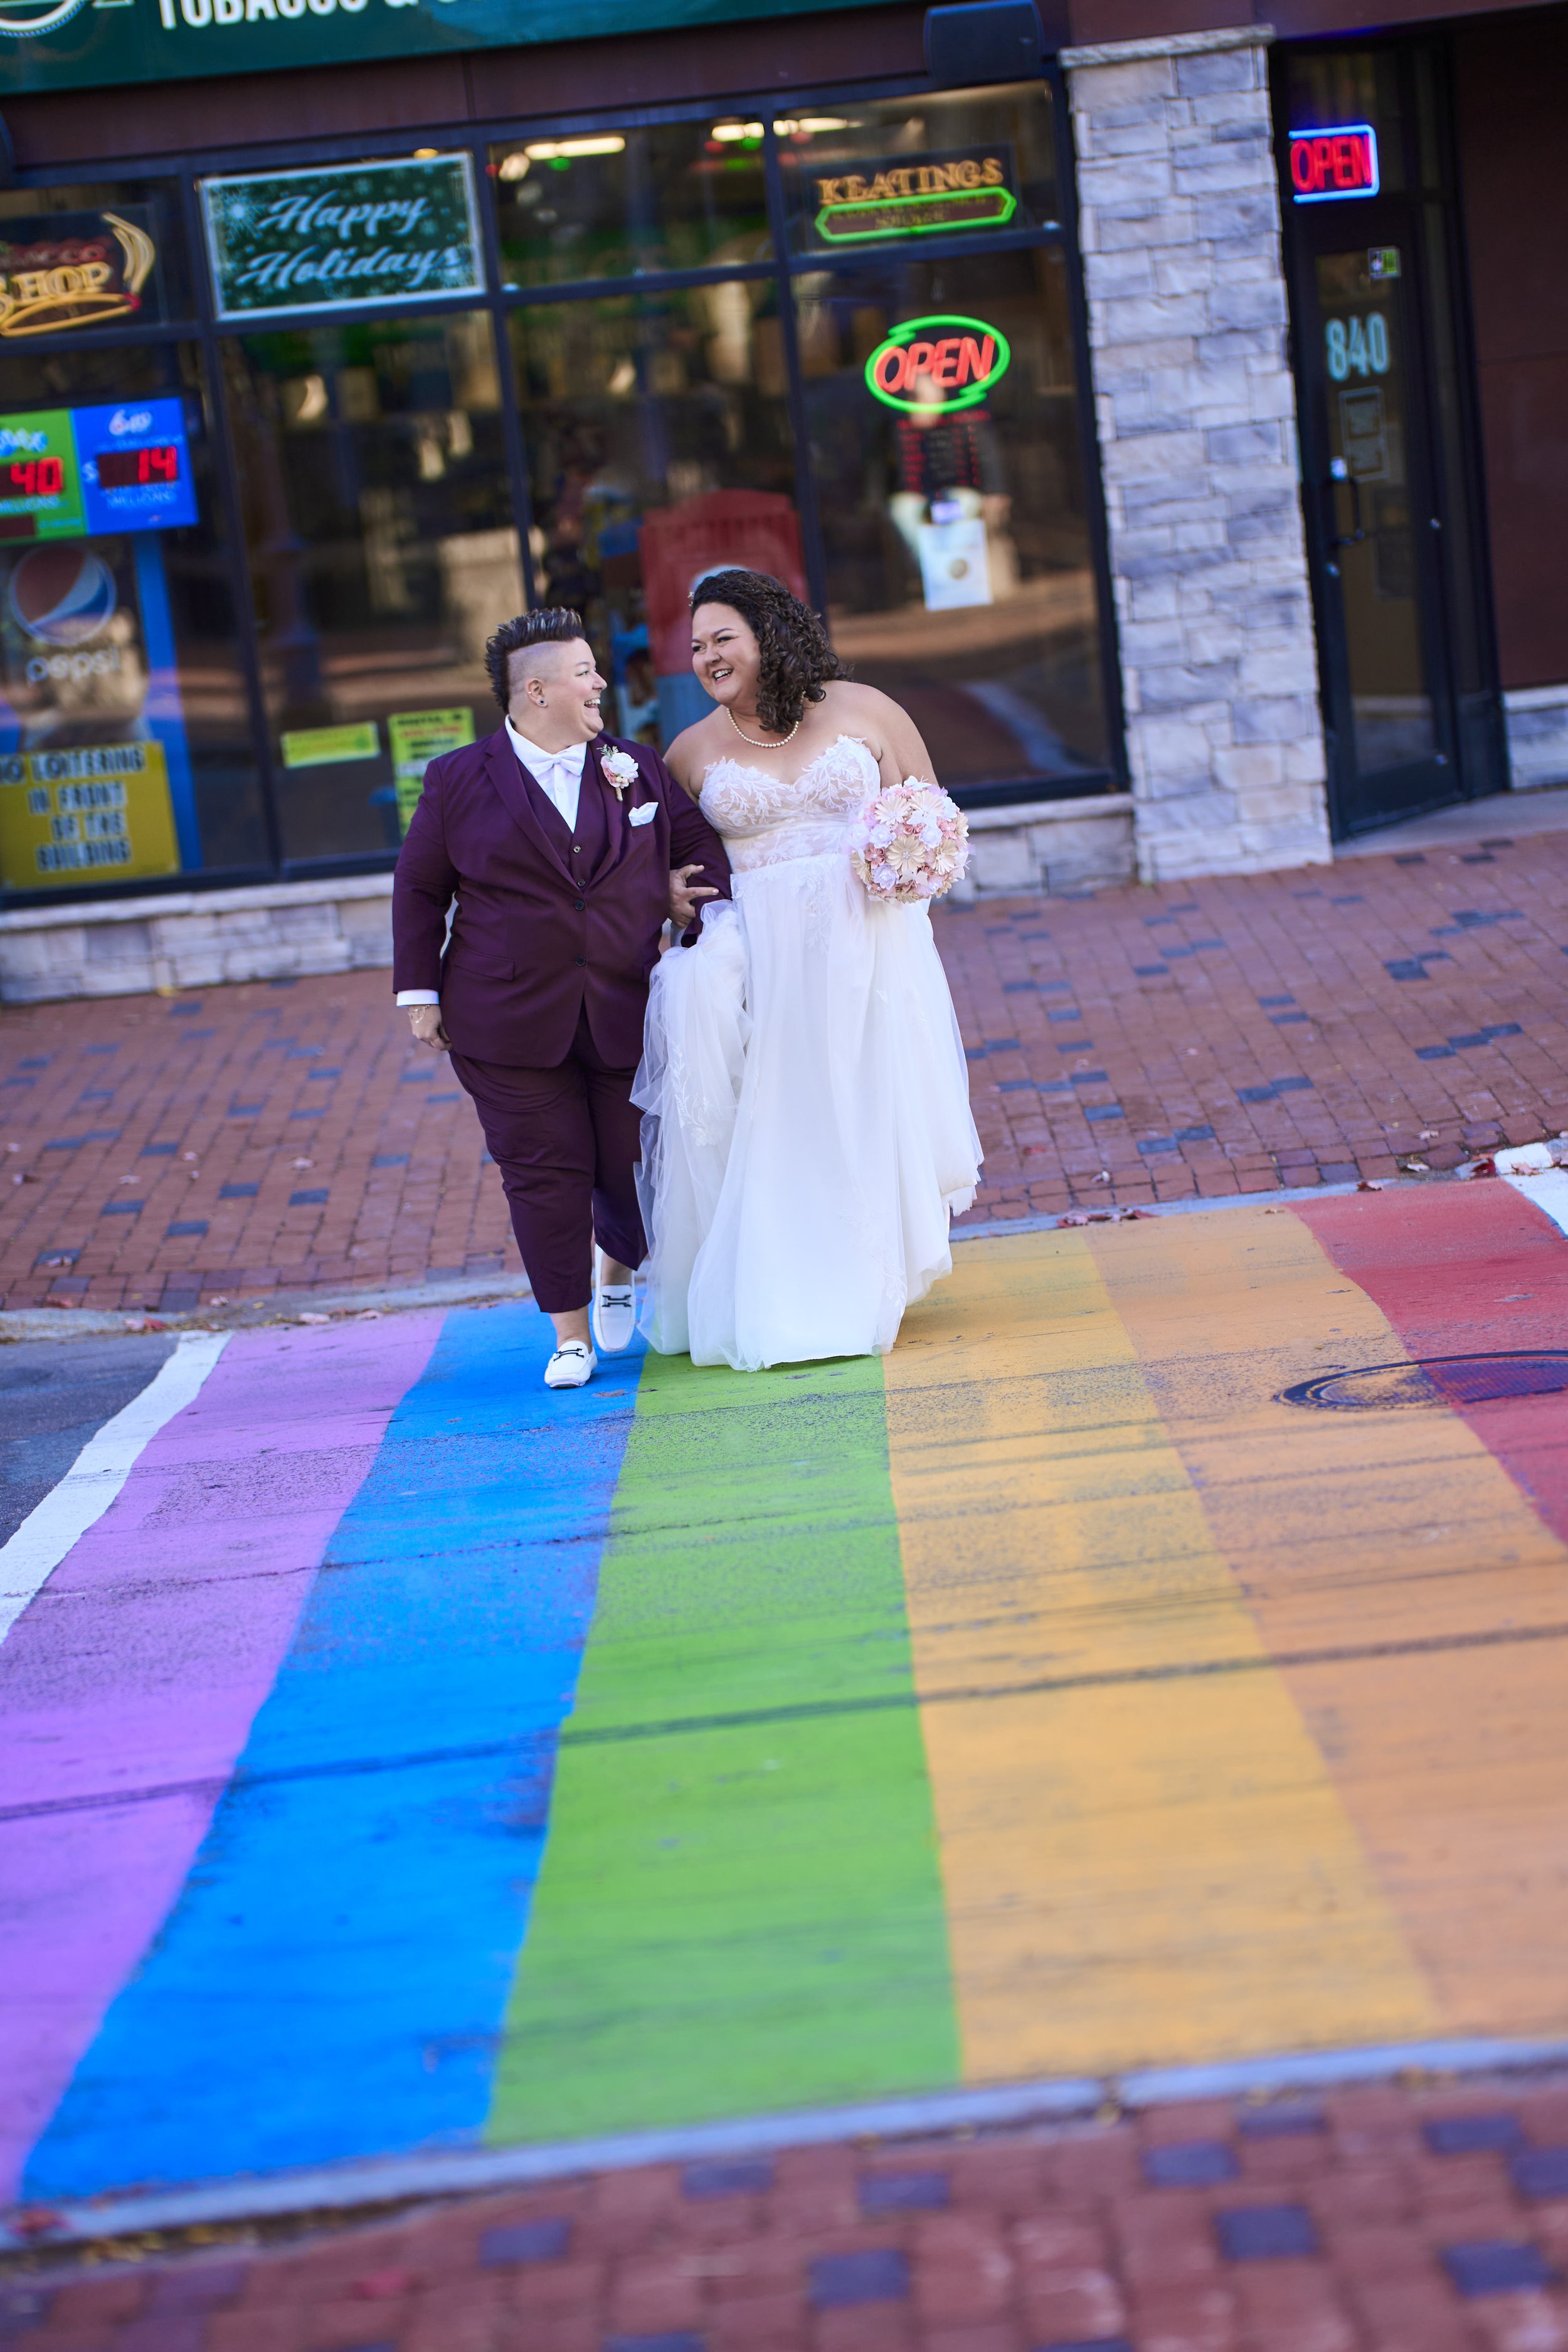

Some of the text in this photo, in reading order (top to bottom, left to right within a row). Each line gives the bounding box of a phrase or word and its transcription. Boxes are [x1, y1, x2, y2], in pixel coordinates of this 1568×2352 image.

[813, 157, 1004, 205] KEATINGS
[1290, 134, 1372, 192] OPEN
[257, 189, 432, 240] Happy
[234, 245, 464, 290] Holidays
[874, 333, 997, 394] OPEN
[1325, 311, 1391, 382] 840
[9, 456, 63, 496] 40
[137, 446, 177, 483] 14
